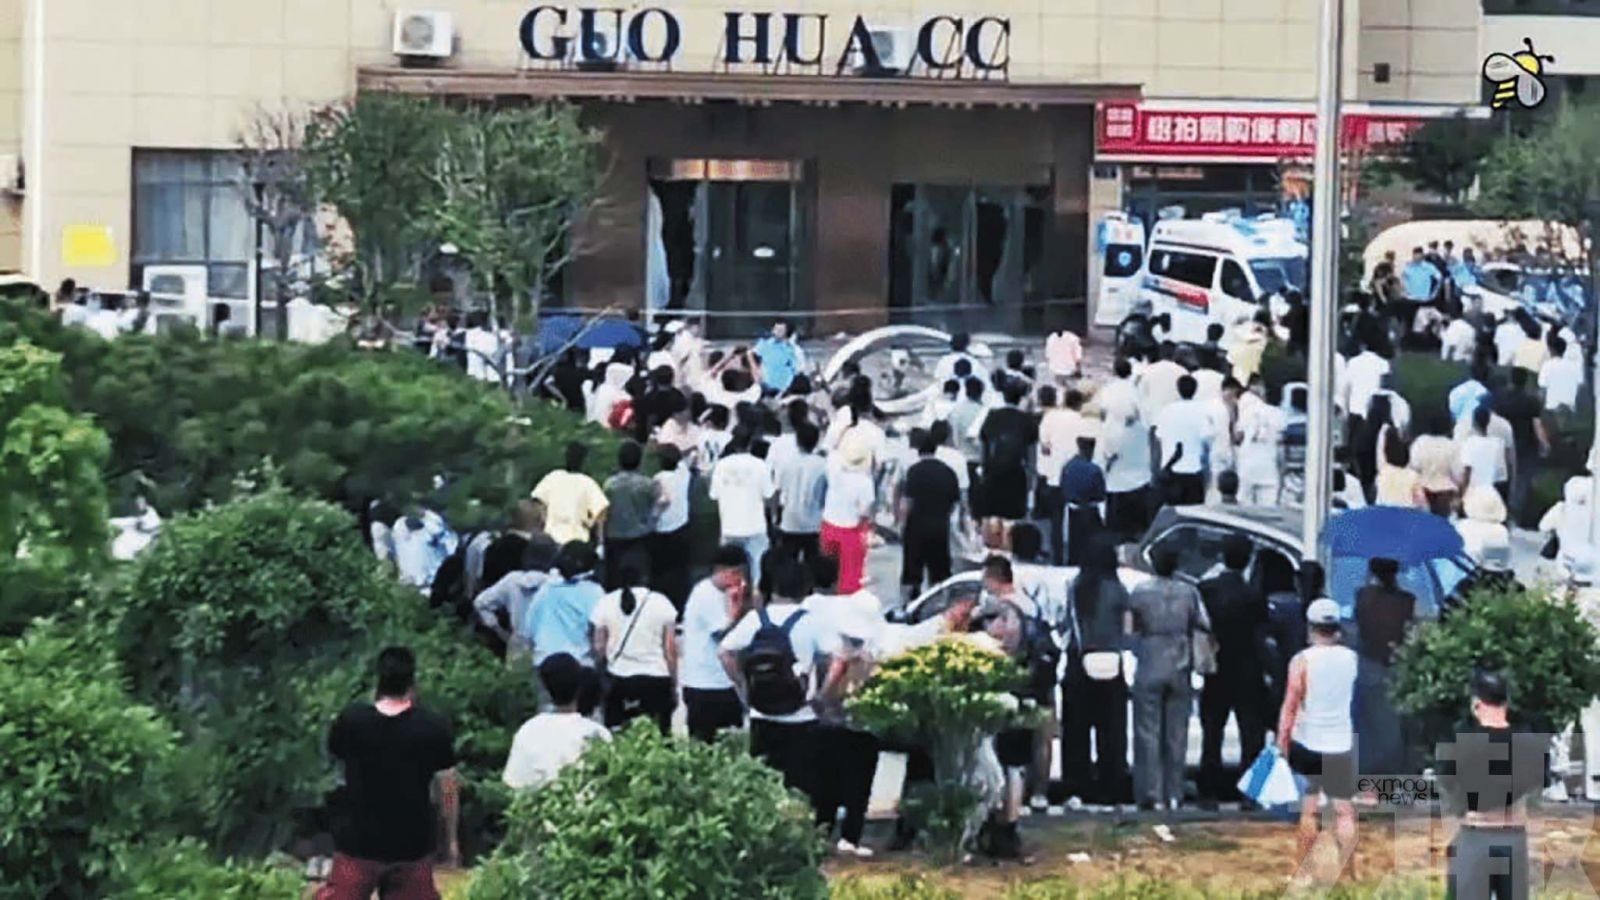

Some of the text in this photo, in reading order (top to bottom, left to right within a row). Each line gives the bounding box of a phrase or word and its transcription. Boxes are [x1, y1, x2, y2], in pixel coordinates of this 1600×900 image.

[519, 6, 1011, 76] GUO HUA CC
